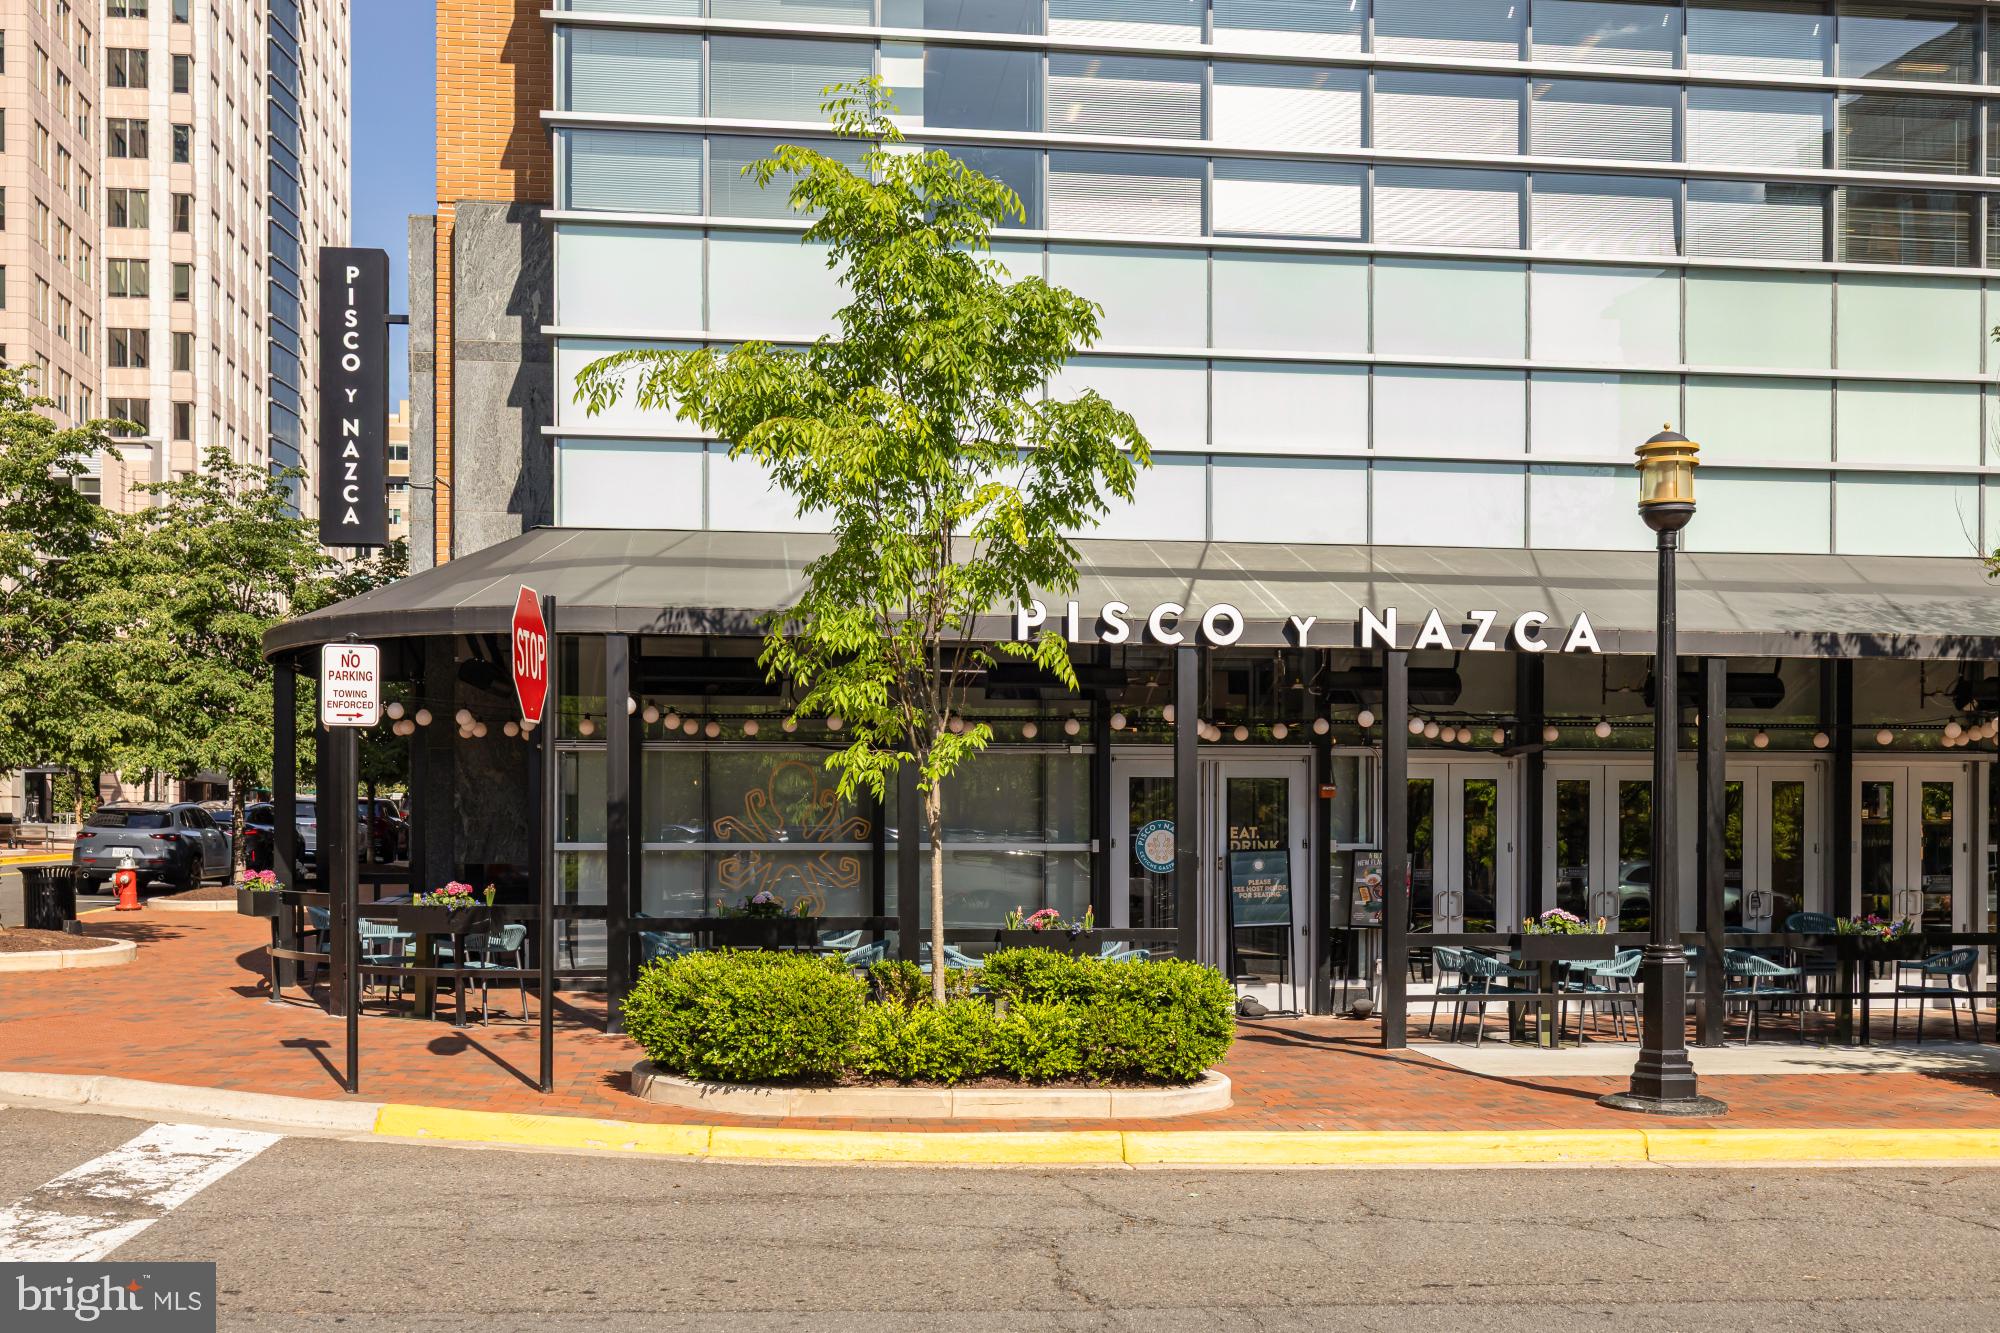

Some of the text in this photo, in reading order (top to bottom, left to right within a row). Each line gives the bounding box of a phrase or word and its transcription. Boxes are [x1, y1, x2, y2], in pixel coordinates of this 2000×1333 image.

[341, 266, 361, 525] PISCO Y NAZCA
[1017, 599, 1601, 653] PISCO Y NAZCA
[341, 654, 361, 668] NO
[517, 627, 545, 680] STOP
[328, 670, 373, 682] PARKING
[333, 689, 368, 698] TOWING
[327, 700, 374, 709] ENFORCED
[1138, 824, 1156, 846] PISCO
[1230, 826, 1260, 839] EAT.
[1139, 851, 1157, 870] CEVICHE
